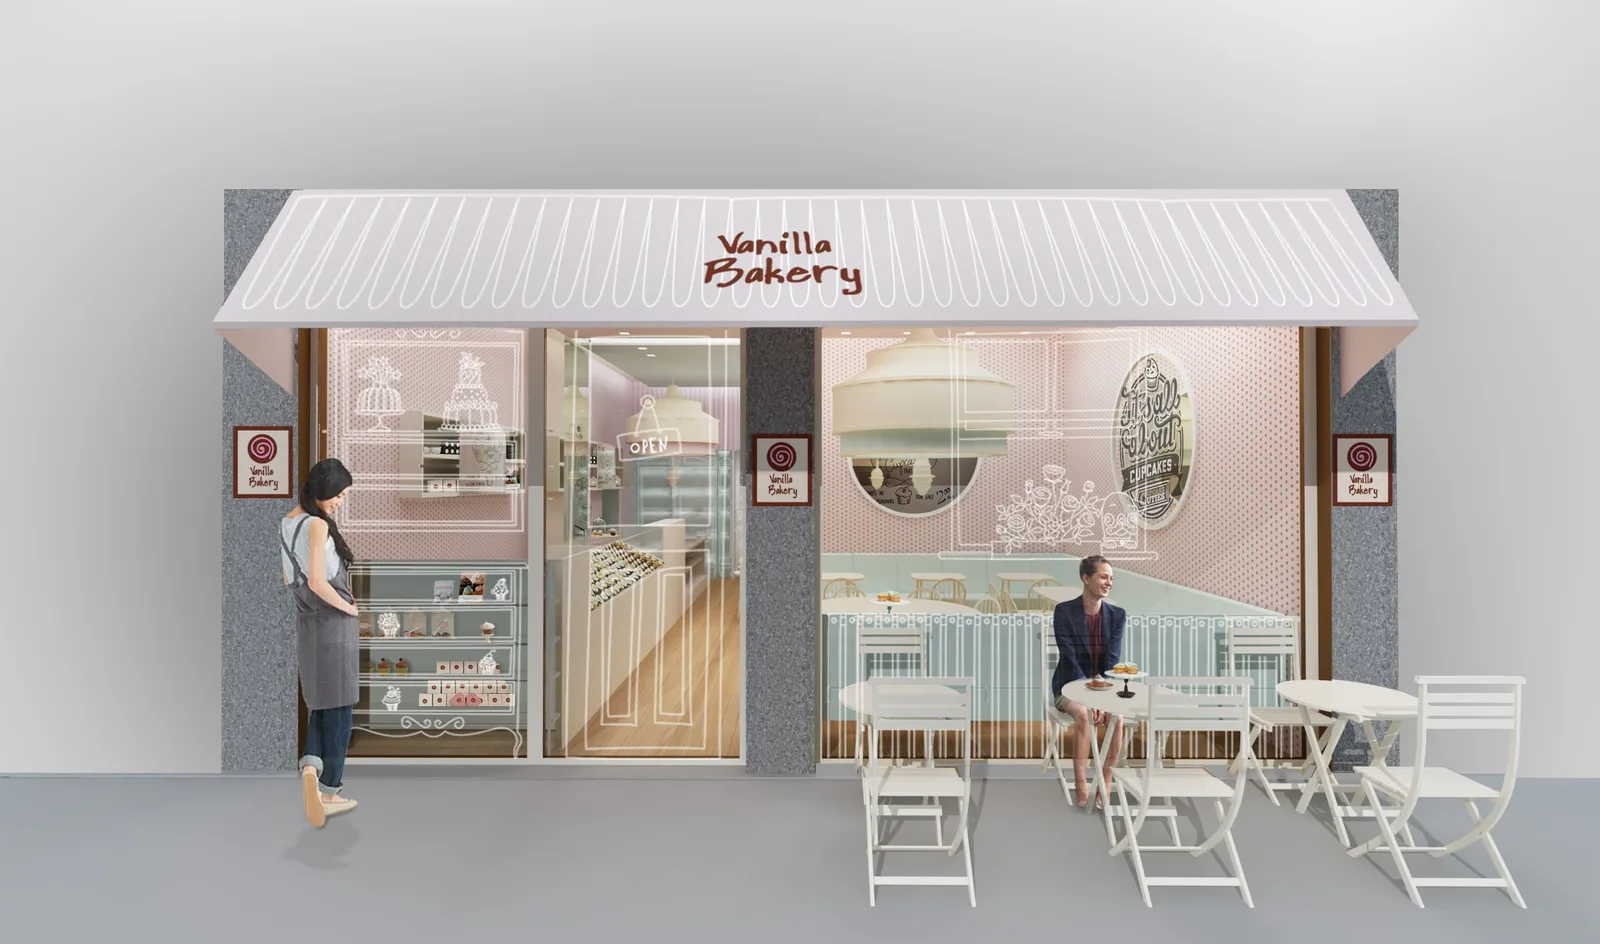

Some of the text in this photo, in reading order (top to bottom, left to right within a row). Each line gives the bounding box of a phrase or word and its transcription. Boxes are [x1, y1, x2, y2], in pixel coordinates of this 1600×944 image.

[717, 231, 832, 255] Vanilla
[704, 257, 862, 295] Bakery
[1121, 412, 1182, 458] about
[630, 436, 669, 454] OPEN
[250, 465, 274, 476] Vanilla
[1129, 458, 1172, 484] CUPCAKES
[249, 476, 279, 491] Bakery
[769, 473, 793, 484] Vanilla
[1349, 473, 1374, 484] Vanilla
[768, 484, 798, 499] Bakery
[1348, 484, 1379, 499] Bakery
